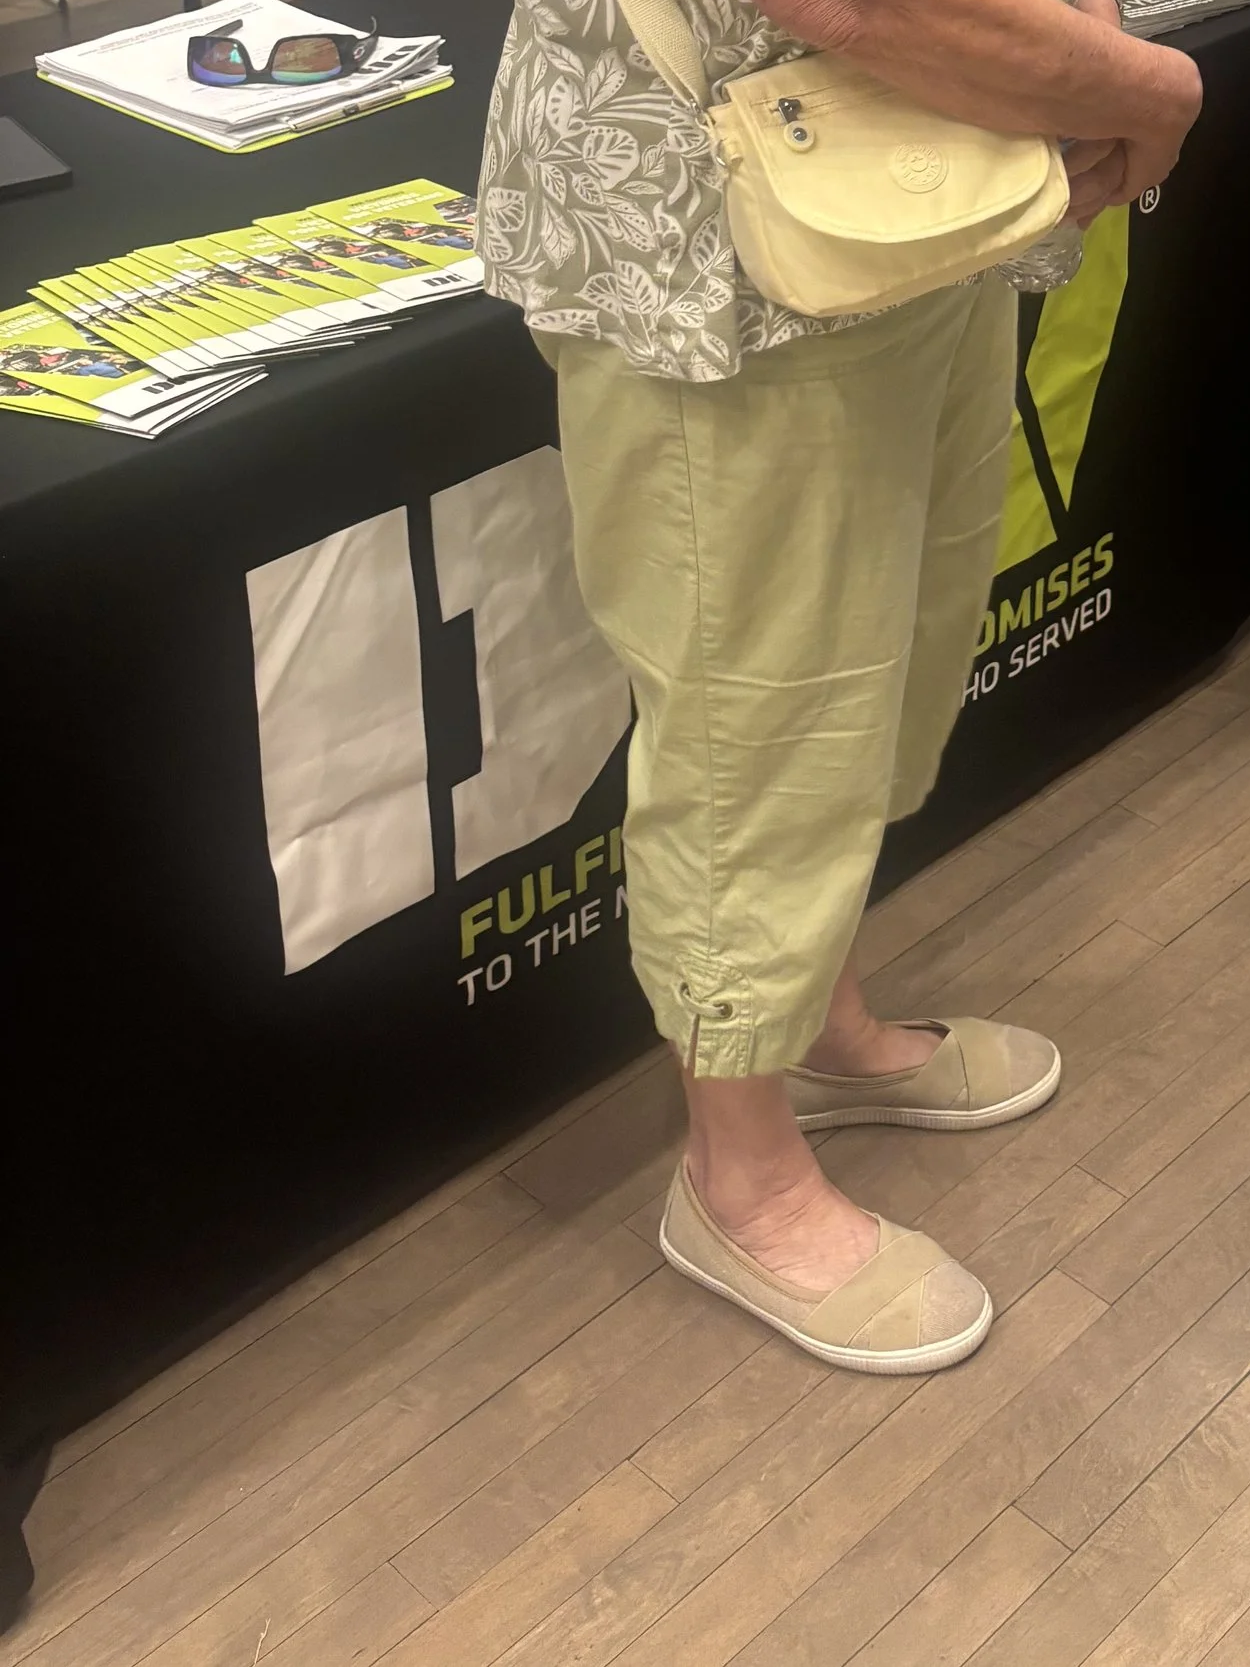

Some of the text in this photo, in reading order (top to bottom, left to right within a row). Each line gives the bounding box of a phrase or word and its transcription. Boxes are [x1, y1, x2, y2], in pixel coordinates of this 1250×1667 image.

[457, 953, 511, 1006] TO
[525, 898, 601, 967] THE
[961, 661, 1000, 708] HO
[1008, 588, 1112, 678] SERVED
[461, 532, 1114, 959] FULFI OMISES
